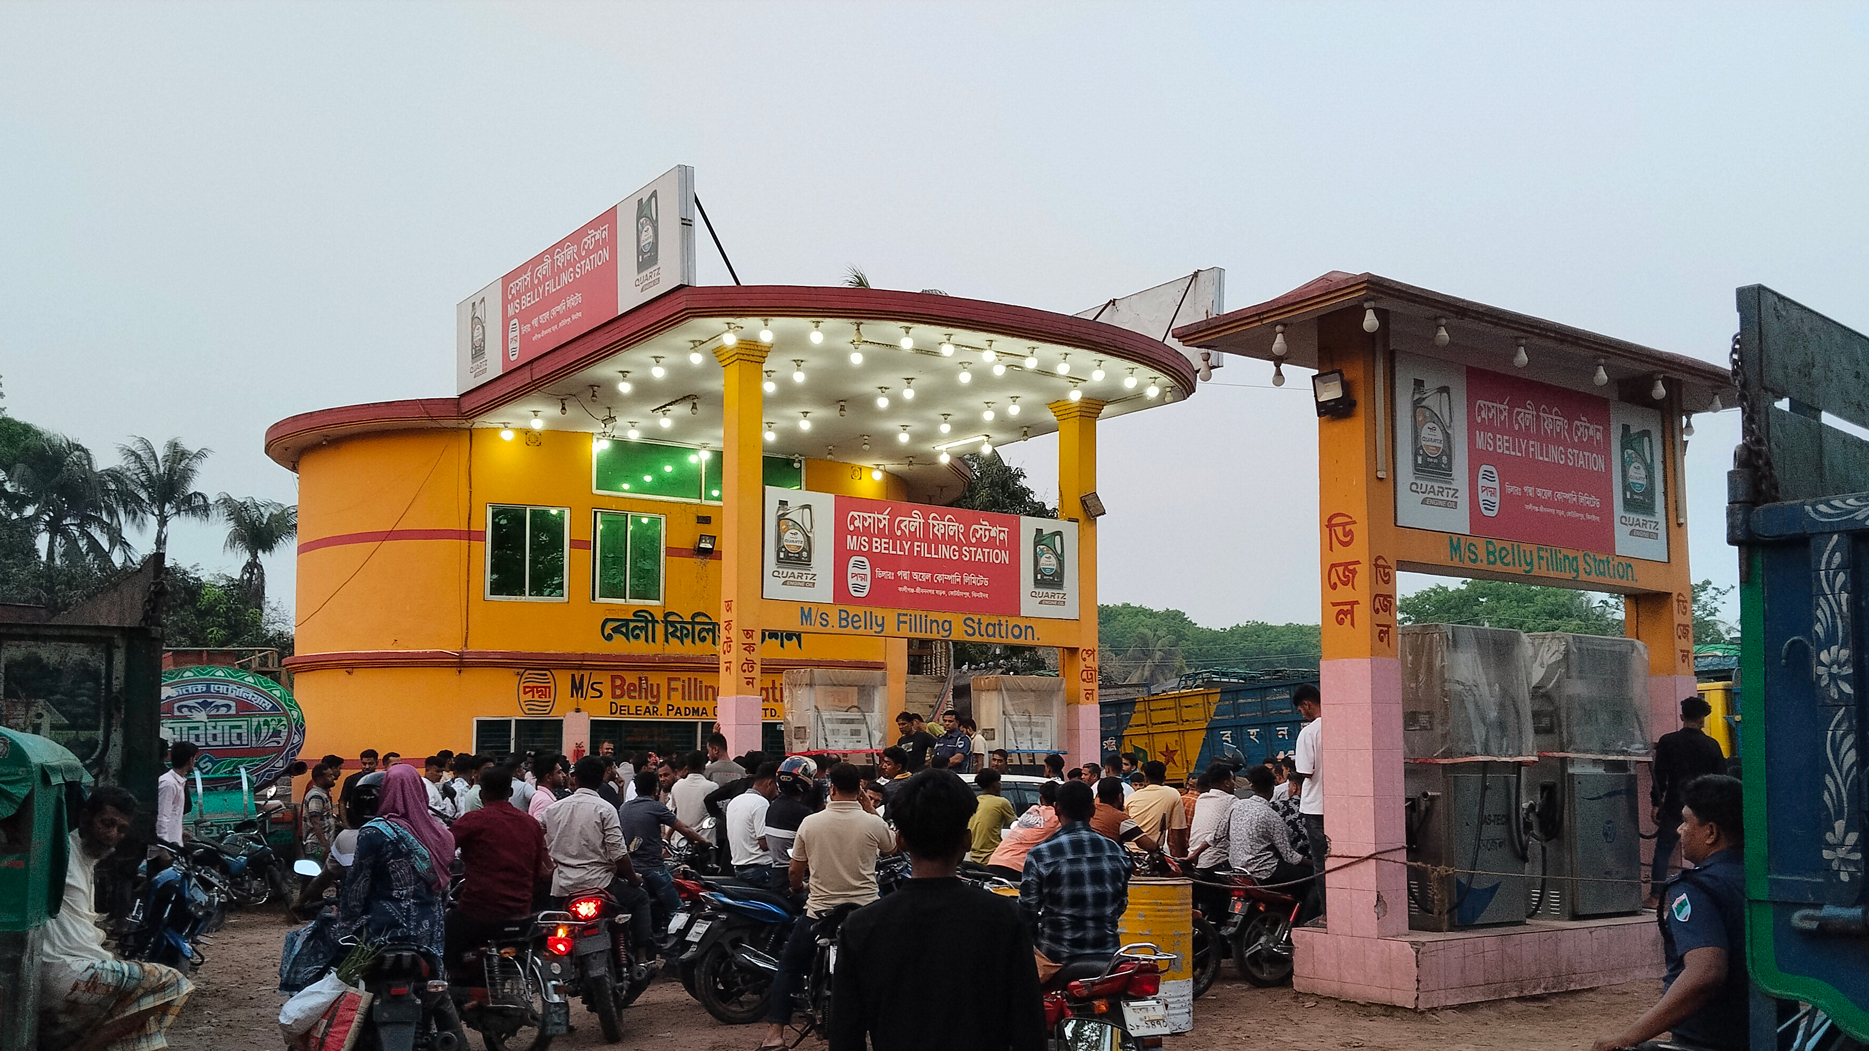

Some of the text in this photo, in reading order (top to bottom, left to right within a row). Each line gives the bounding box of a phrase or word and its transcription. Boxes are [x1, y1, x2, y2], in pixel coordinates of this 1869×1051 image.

[507, 224, 609, 300] মেসার্স বেলী ফিলিং স্টেশন
[507, 246, 609, 318] M/S BELLY FILLING STATION
[635, 266, 661, 287] QUARTZ
[1475, 396, 1603, 449] মেসার্স বেলী ফিলিং স্টেশন
[1475, 430, 1605, 472] M/S BELLY FILLING STATION
[1410, 482, 1459, 499] QUARTZ
[1425, 498, 1456, 508] ENGINE OIL
[847, 507, 1009, 547] মেসার্স বেলী ফিলিং স্টেশন
[1620, 515, 1659, 531] QUARTZ
[847, 535, 1009, 564] M/S BELLY FILLING STATION
[1449, 536, 1638, 583] M/s. Belly Filling Station.
[772, 570, 817, 581] QUARTZ
[851, 572, 868, 582] পদ্মা
[897, 570, 910, 581] পদ্মা
[1030, 590, 1067, 600] QUARTZ
[601, 609, 660, 645] বেলী
[800, 607, 1040, 641] M/s. Belly Filling Station.
[523, 685, 551, 699] পদ্মা
[570, 672, 720, 705] M/s Belly Fillin
[609, 701, 663, 717] DELEAR.
[667, 704, 709, 717] PADMA
[763, 708, 780, 718] TD.
